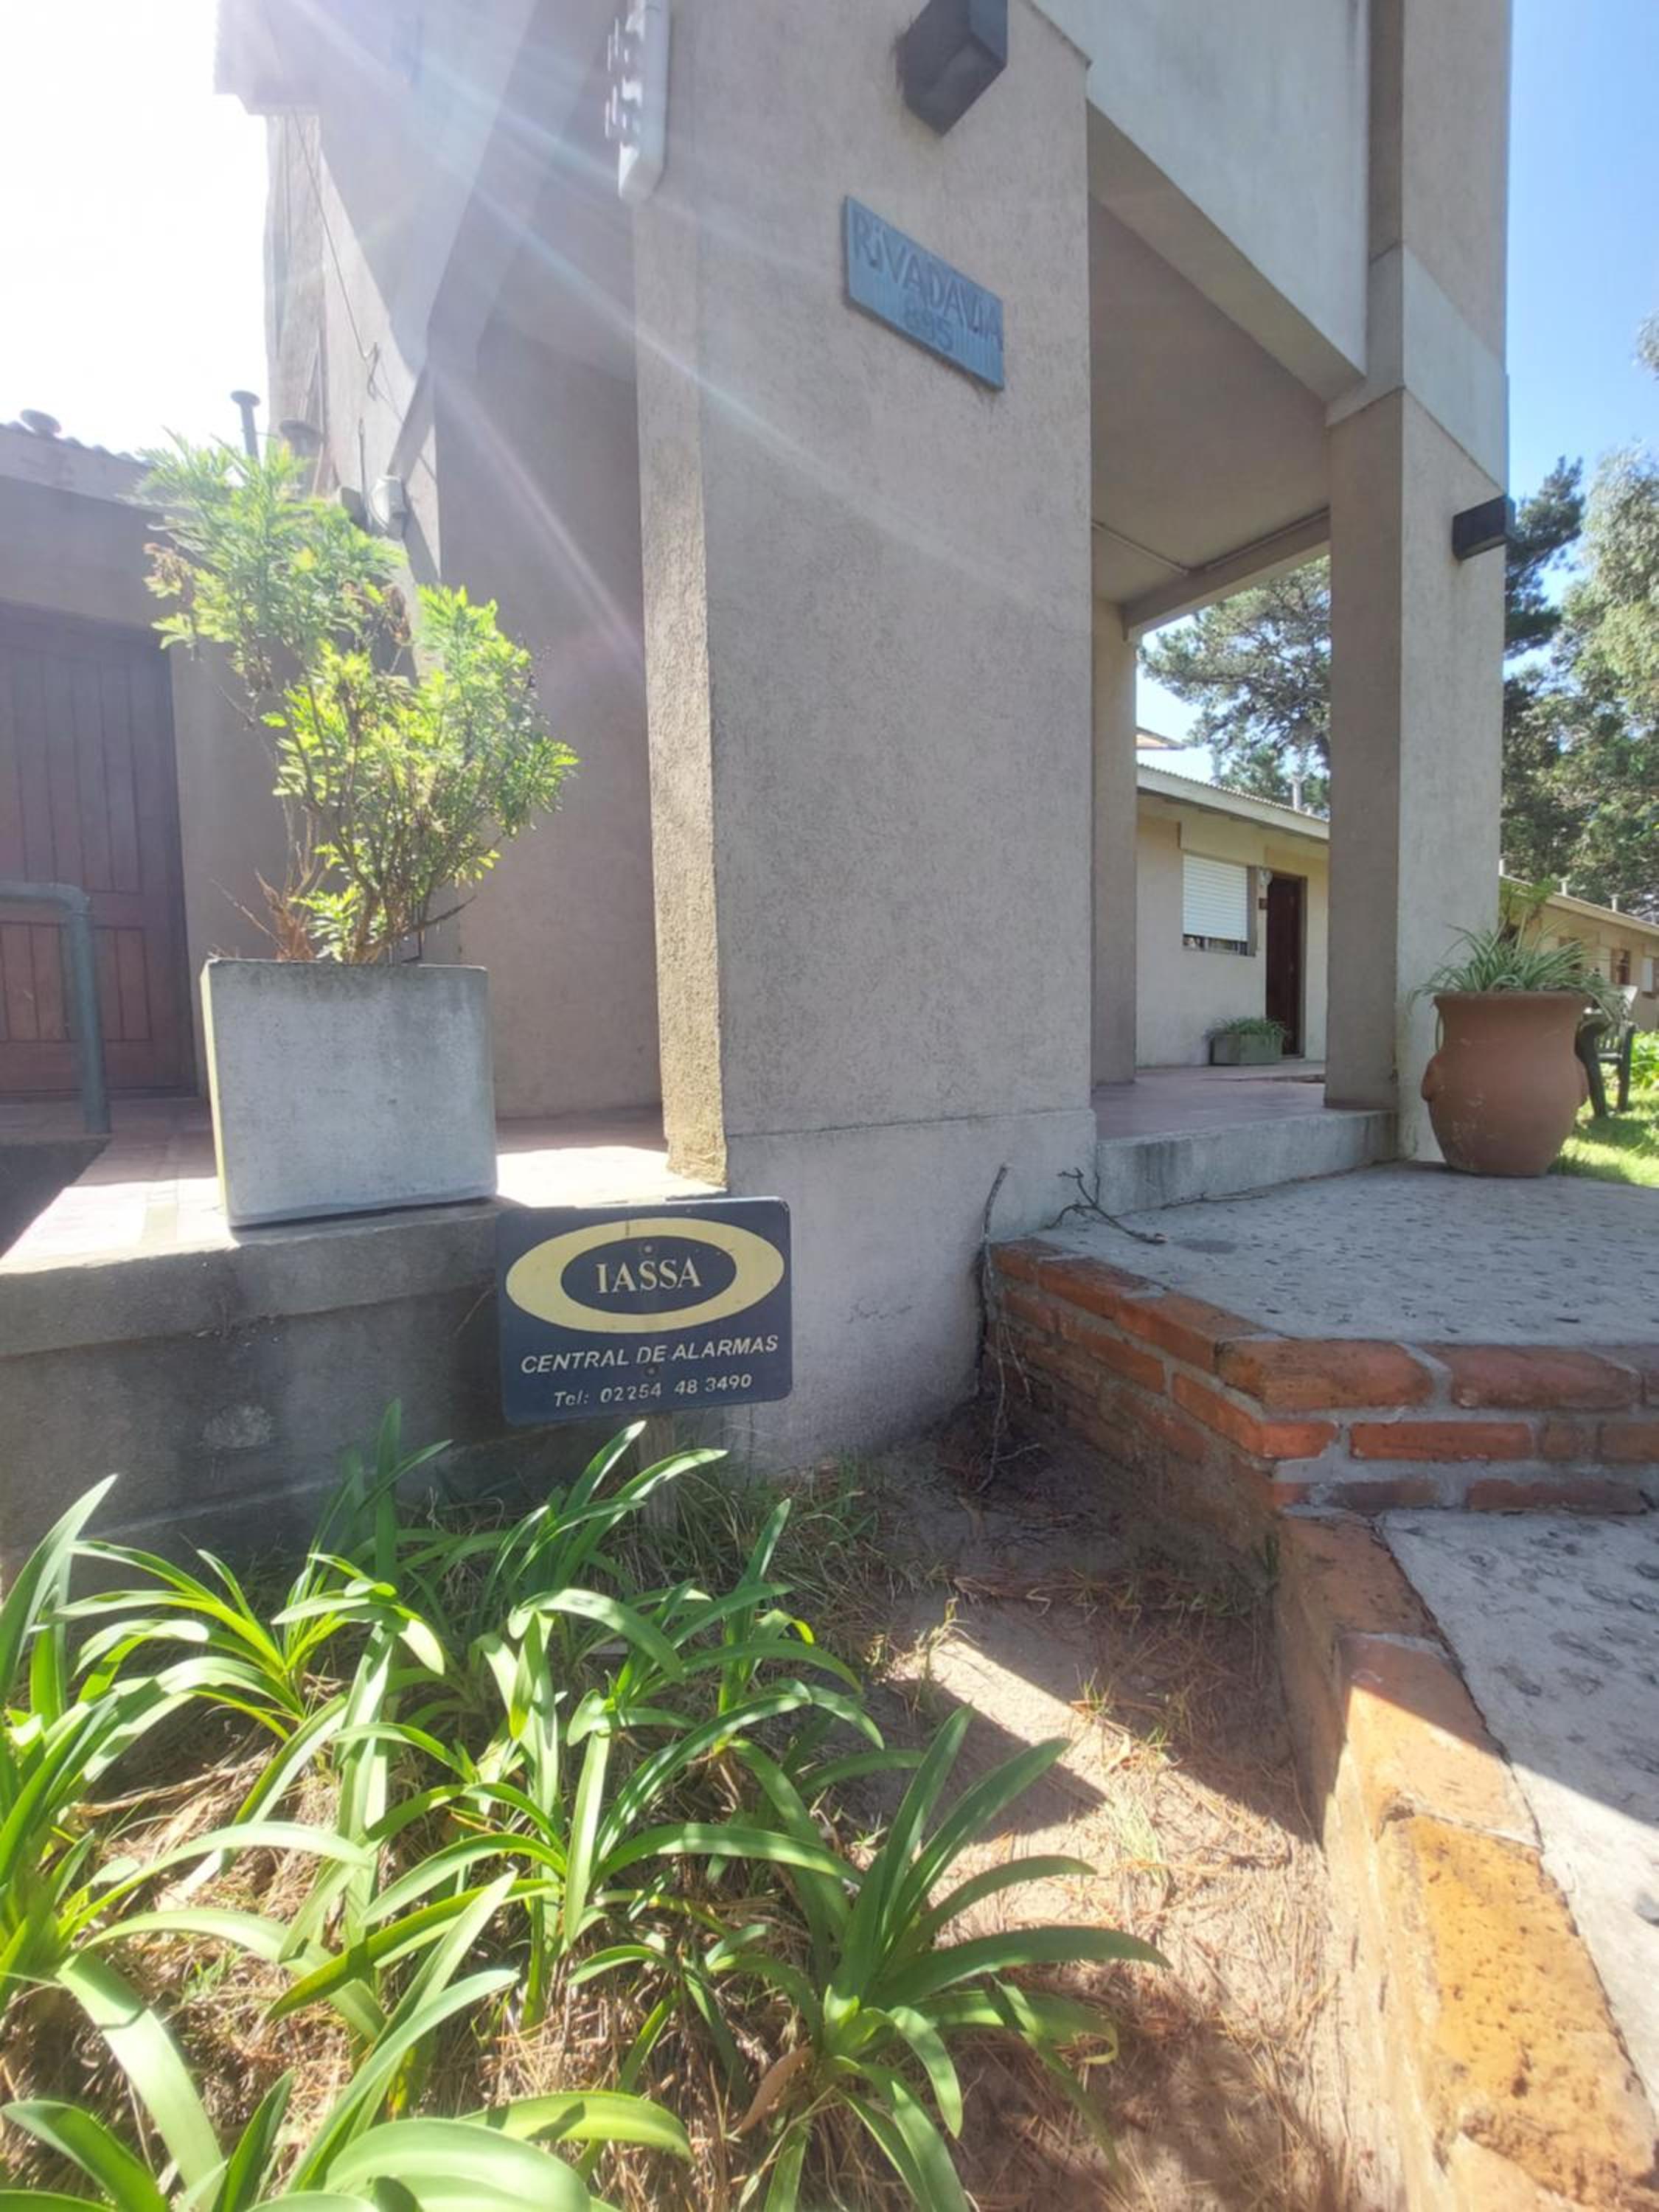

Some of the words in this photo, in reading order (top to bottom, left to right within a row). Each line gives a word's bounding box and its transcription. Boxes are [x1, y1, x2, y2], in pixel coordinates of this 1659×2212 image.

[596, 1257, 701, 1294] IASSA
[521, 1348, 629, 1374] CENTRAL
[636, 1344, 667, 1364] DE
[672, 1335, 779, 1361] ALARMAS
[554, 1391, 589, 1407] Tel:
[600, 1382, 662, 1403] 02254
[674, 1378, 698, 1395] 48
[706, 1374, 752, 1393] 3490
